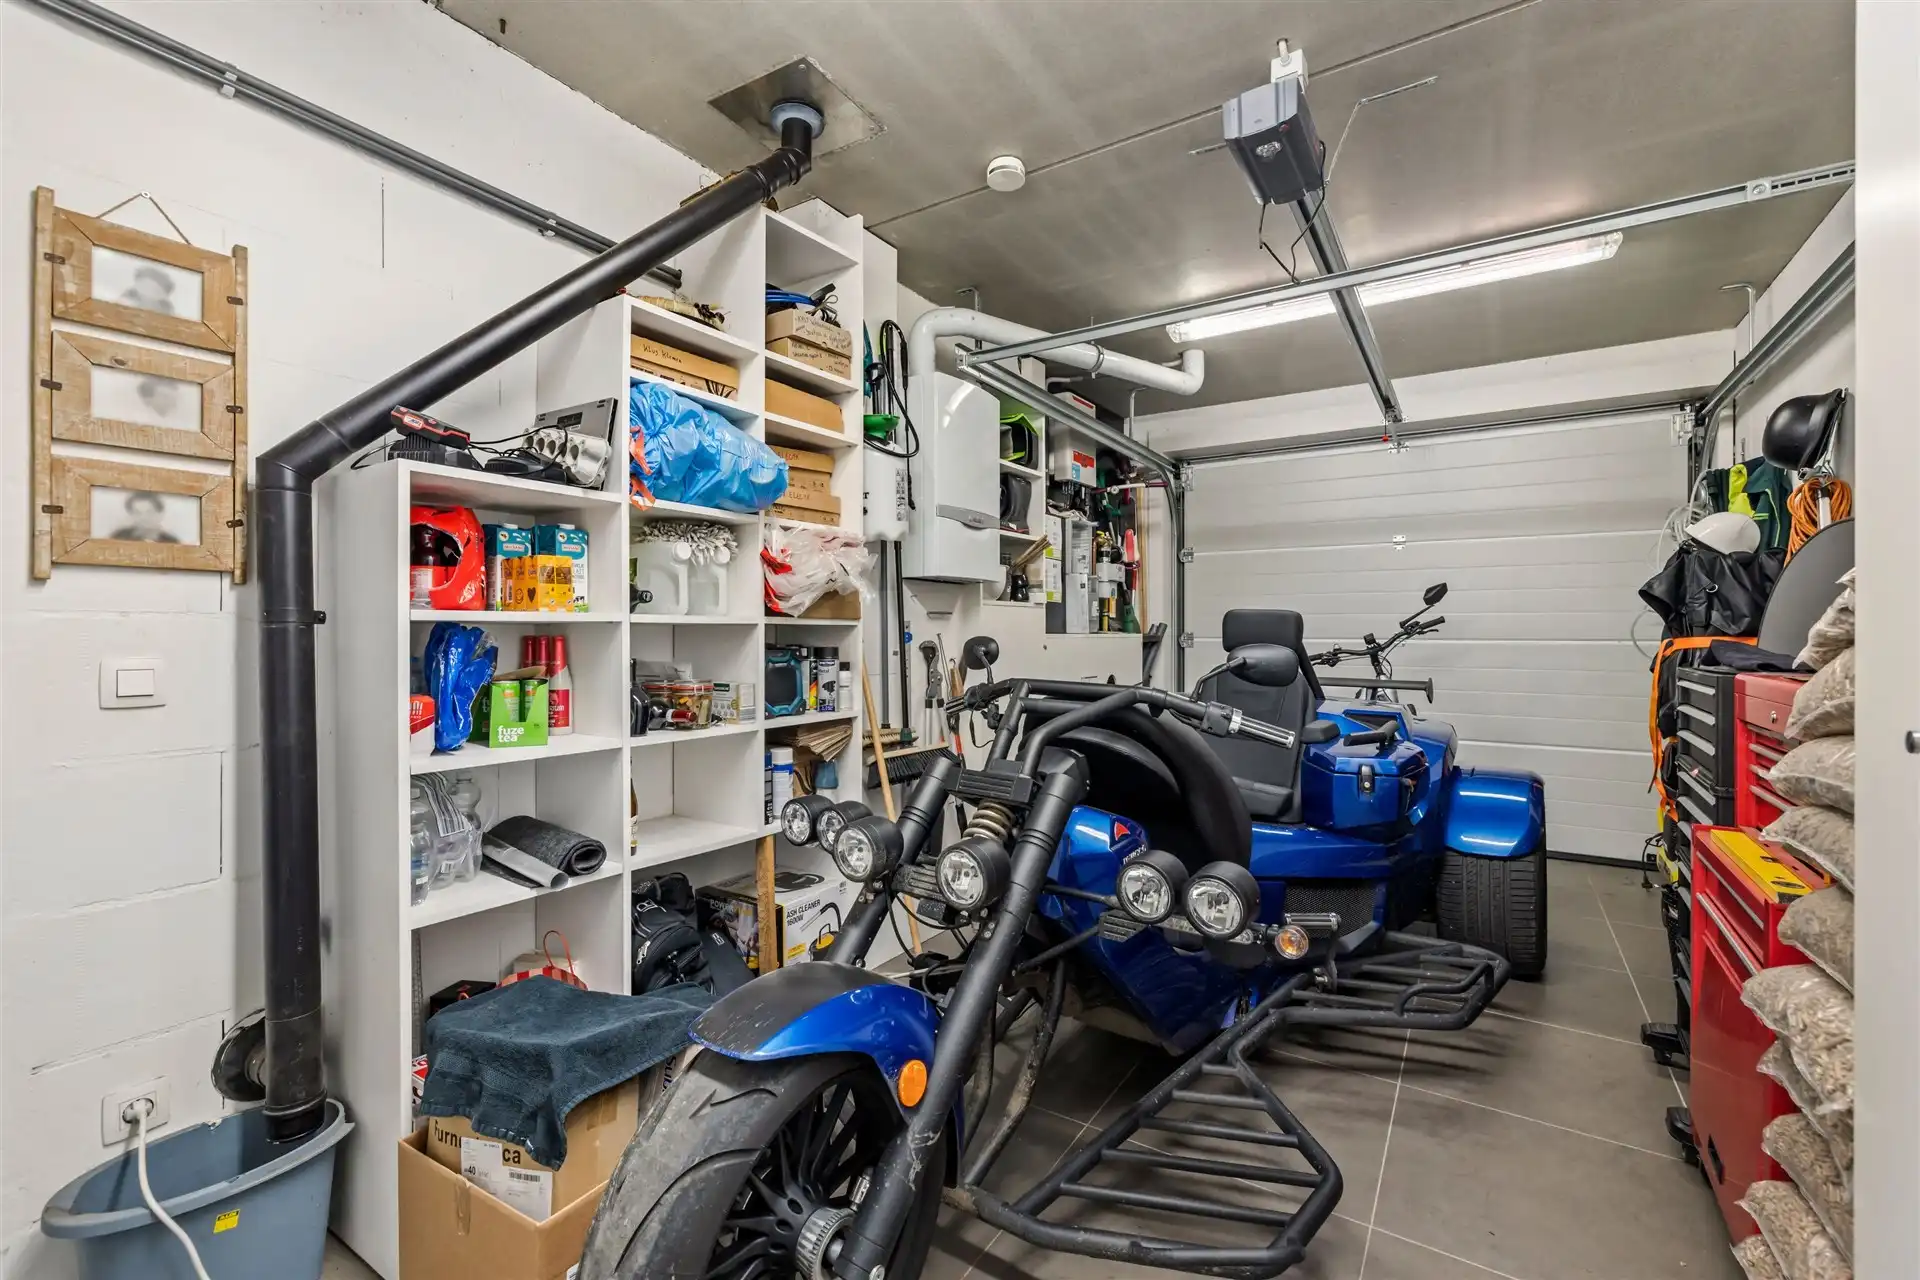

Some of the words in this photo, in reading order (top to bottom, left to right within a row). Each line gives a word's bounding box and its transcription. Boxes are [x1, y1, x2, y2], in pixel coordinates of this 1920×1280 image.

[497, 725, 525, 735] fuze
[498, 733, 519, 743] tea
[786, 911, 798, 919] ASH
[798, 899, 821, 914] CLEANER
[468, 1165, 476, 1176] 40
